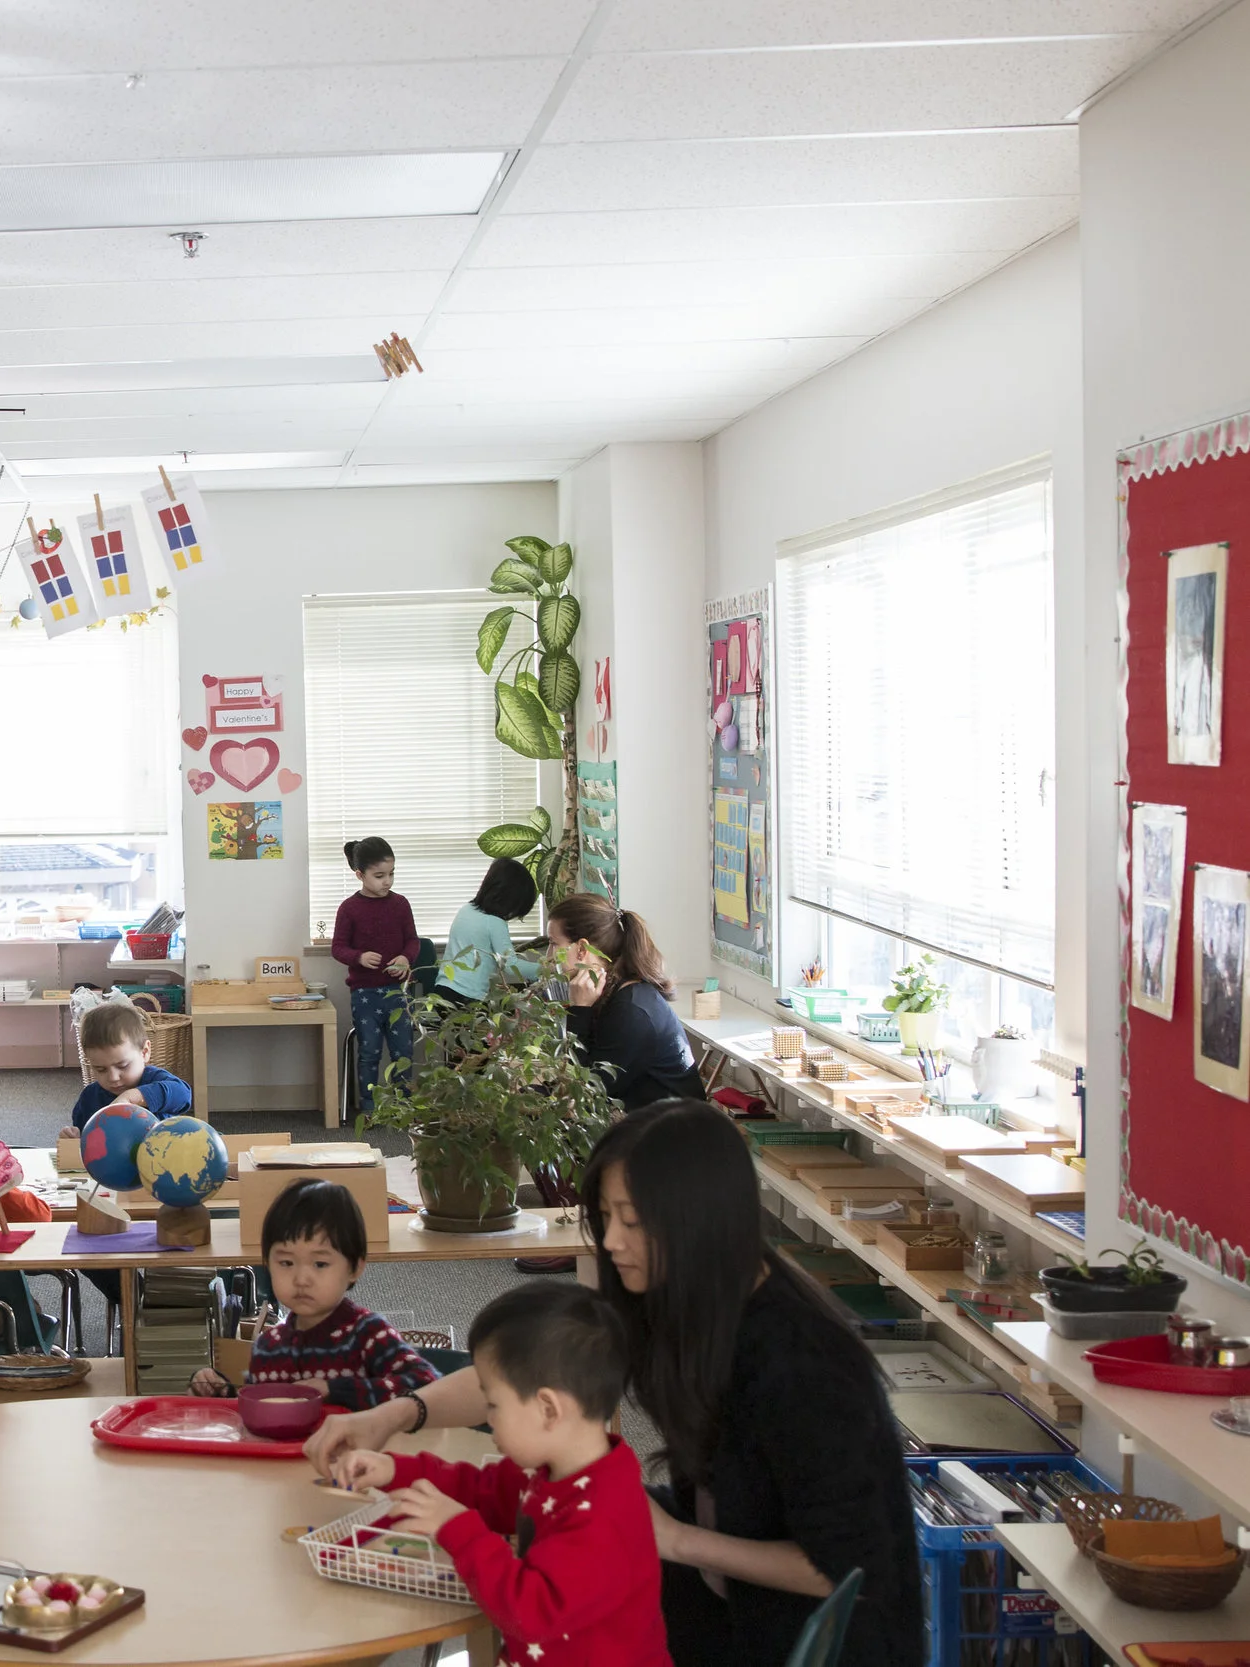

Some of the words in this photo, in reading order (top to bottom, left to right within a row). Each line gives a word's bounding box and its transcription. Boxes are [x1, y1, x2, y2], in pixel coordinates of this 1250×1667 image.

[226, 688, 254, 696] Happy
[222, 714, 268, 723] Valentine's
[262, 962, 292, 975] Bank
